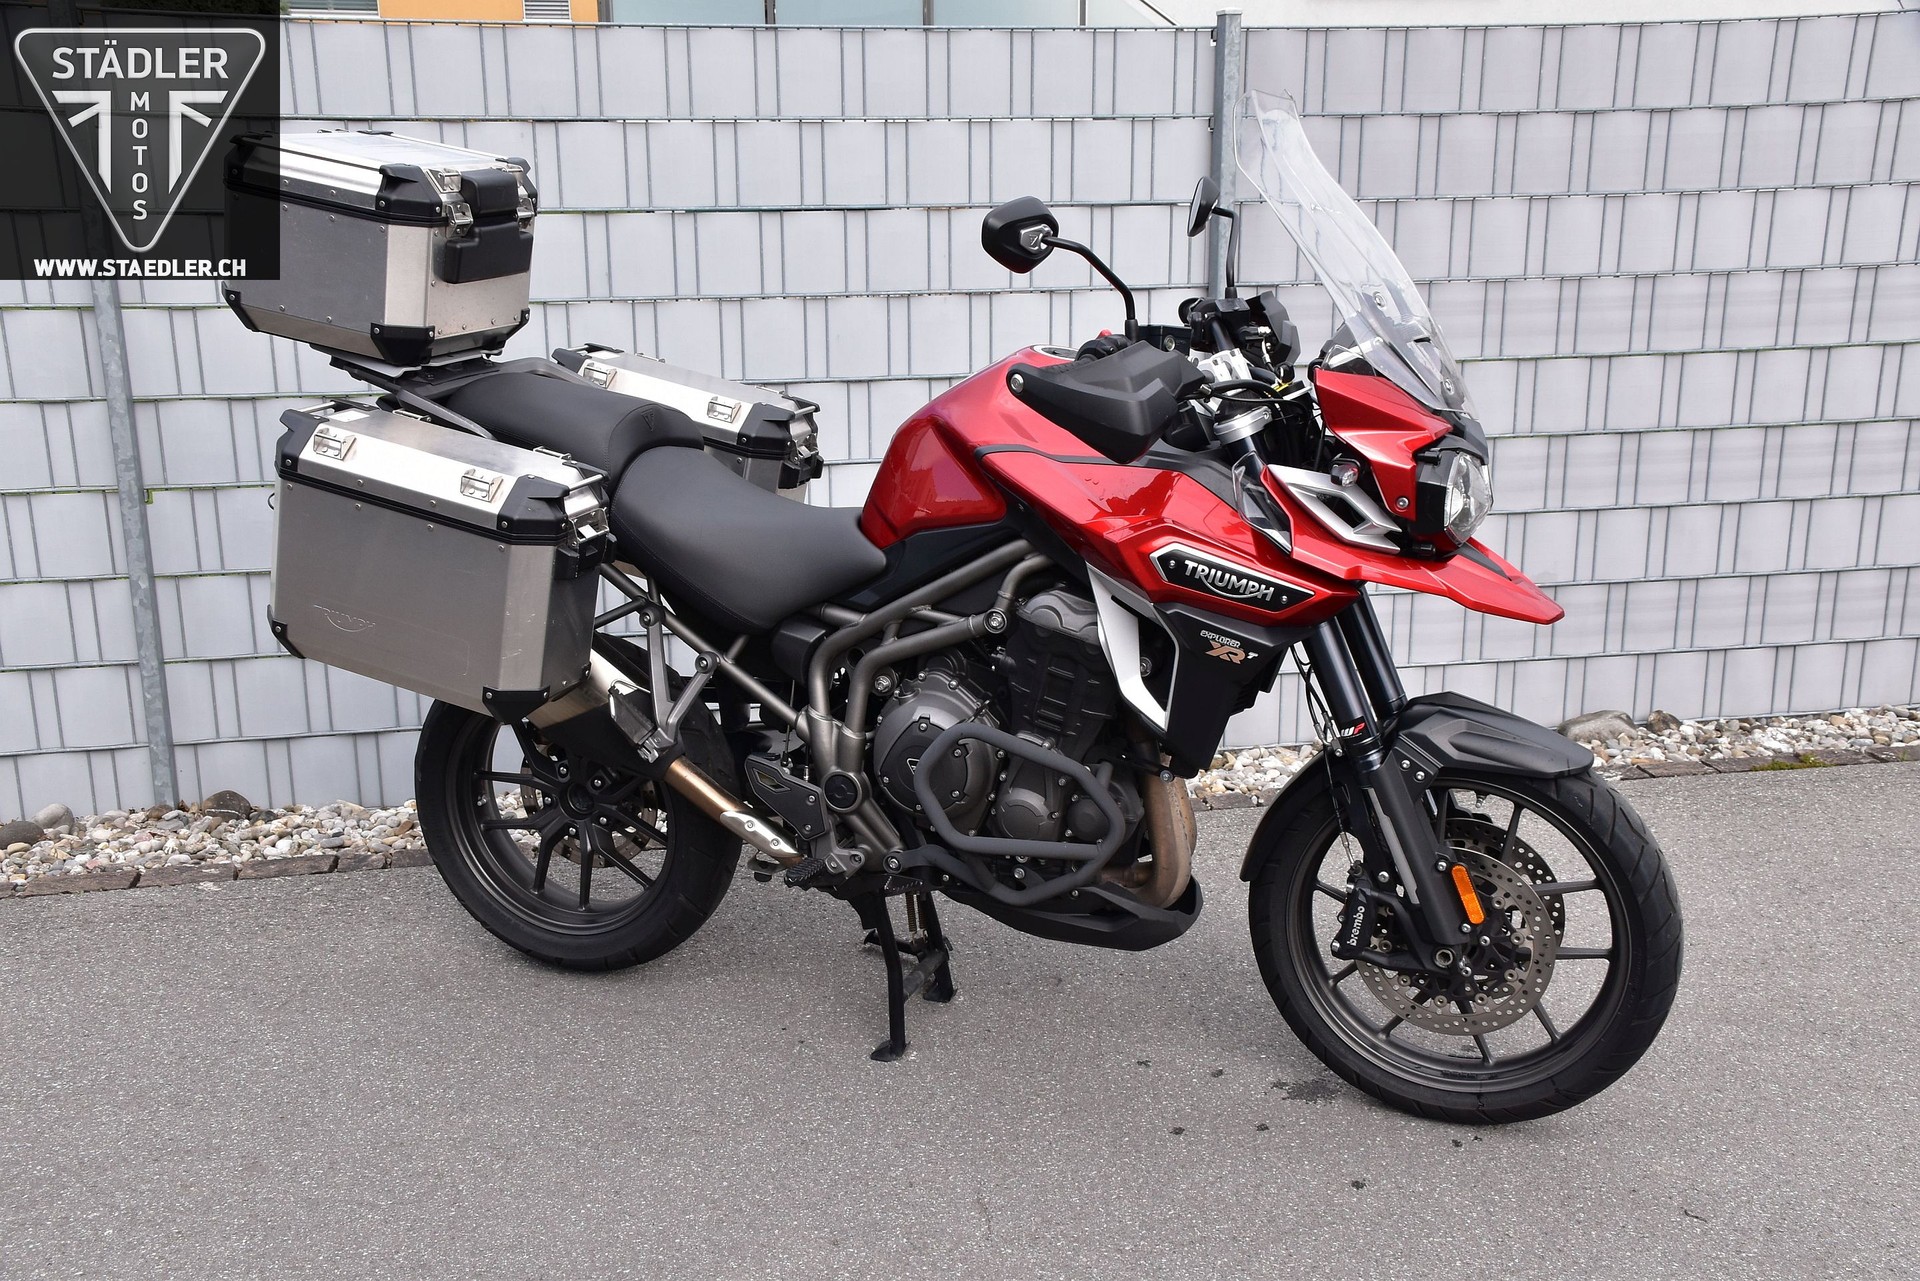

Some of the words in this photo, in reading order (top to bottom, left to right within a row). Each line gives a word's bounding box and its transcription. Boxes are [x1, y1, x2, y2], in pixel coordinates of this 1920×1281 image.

[1184, 560, 1275, 602] TRIUMPH
[1200, 629, 1241, 648] EXPLORER
[1346, 906, 1365, 947] brembo
